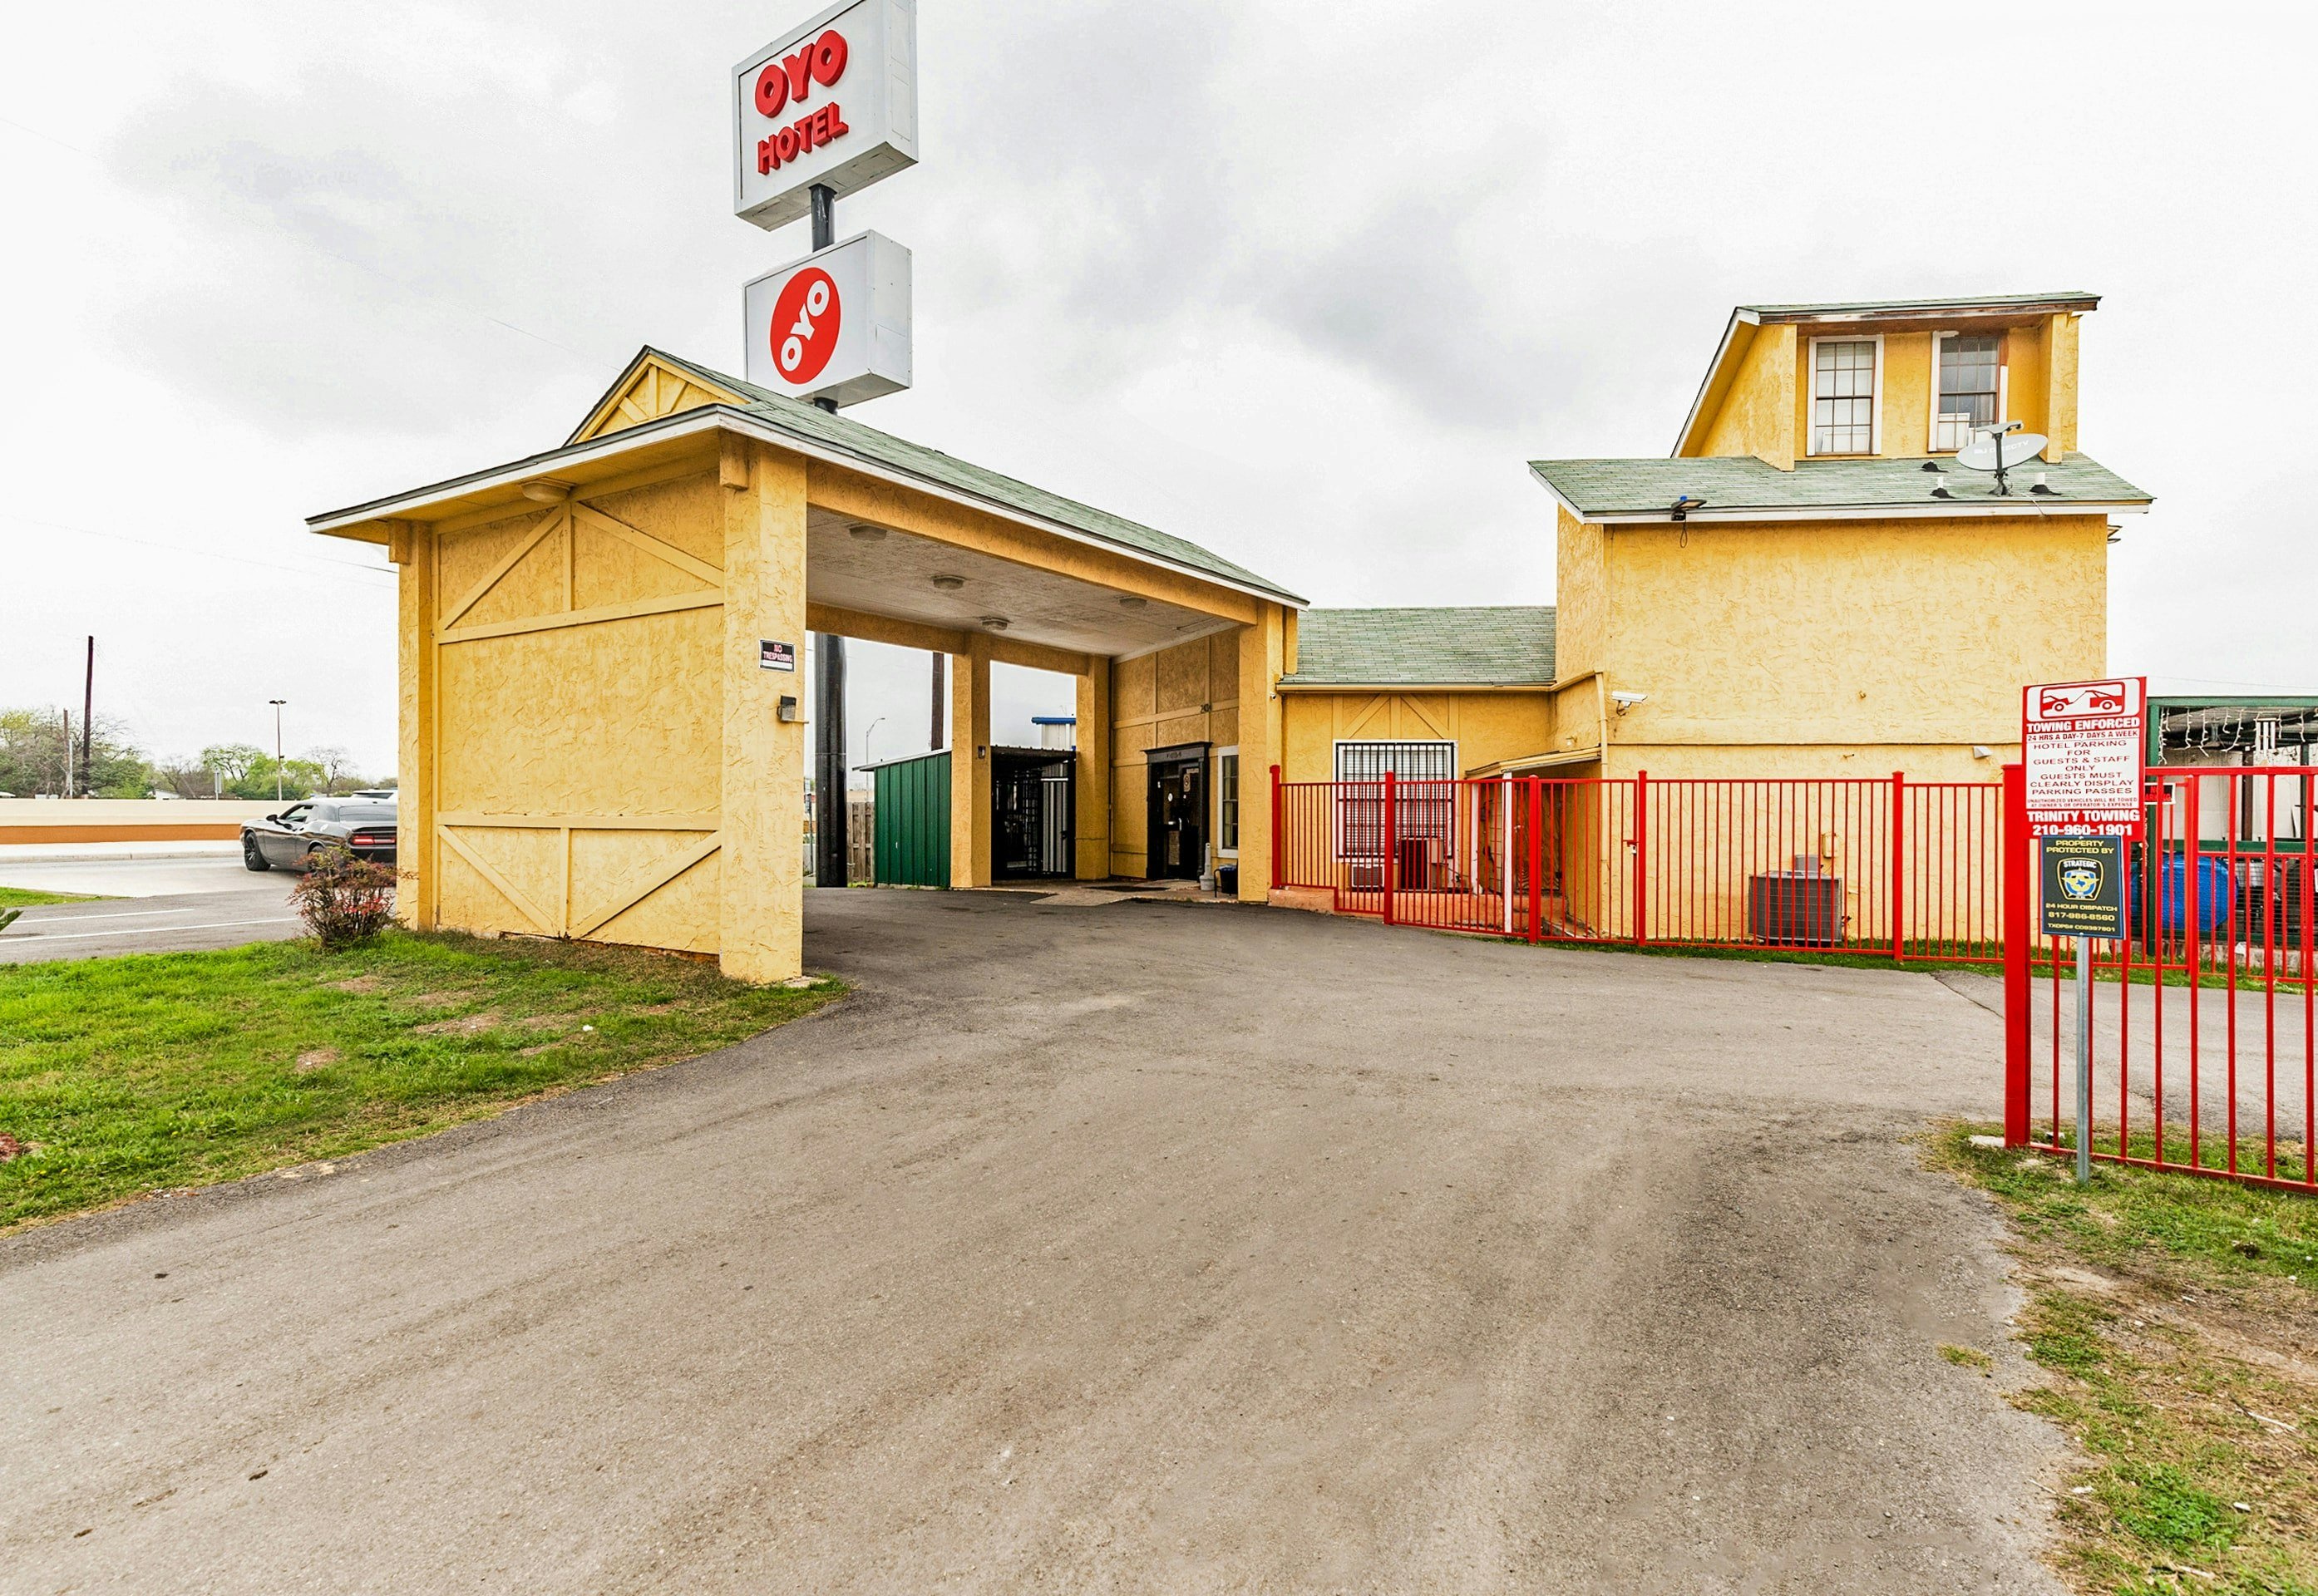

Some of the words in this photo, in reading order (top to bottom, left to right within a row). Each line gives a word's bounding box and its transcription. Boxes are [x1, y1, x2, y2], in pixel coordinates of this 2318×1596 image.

[754, 29, 848, 118] OYO
[757, 101, 849, 175] HOTEL
[780, 279, 830, 372] OYO
[774, 644, 782, 653] NO
[763, 651, 792, 663] TRESPASSING
[2026, 721, 2072, 733] TOWING
[2074, 717, 2140, 731] ENFORCED
[2074, 740, 2127, 748] PARKING
[2026, 810, 2079, 822] TRINITY
[2082, 810, 2140, 822] TOWING
[2032, 824, 2133, 835] 210-960-1901
[2063, 860, 2097, 869] STRATEGIC
